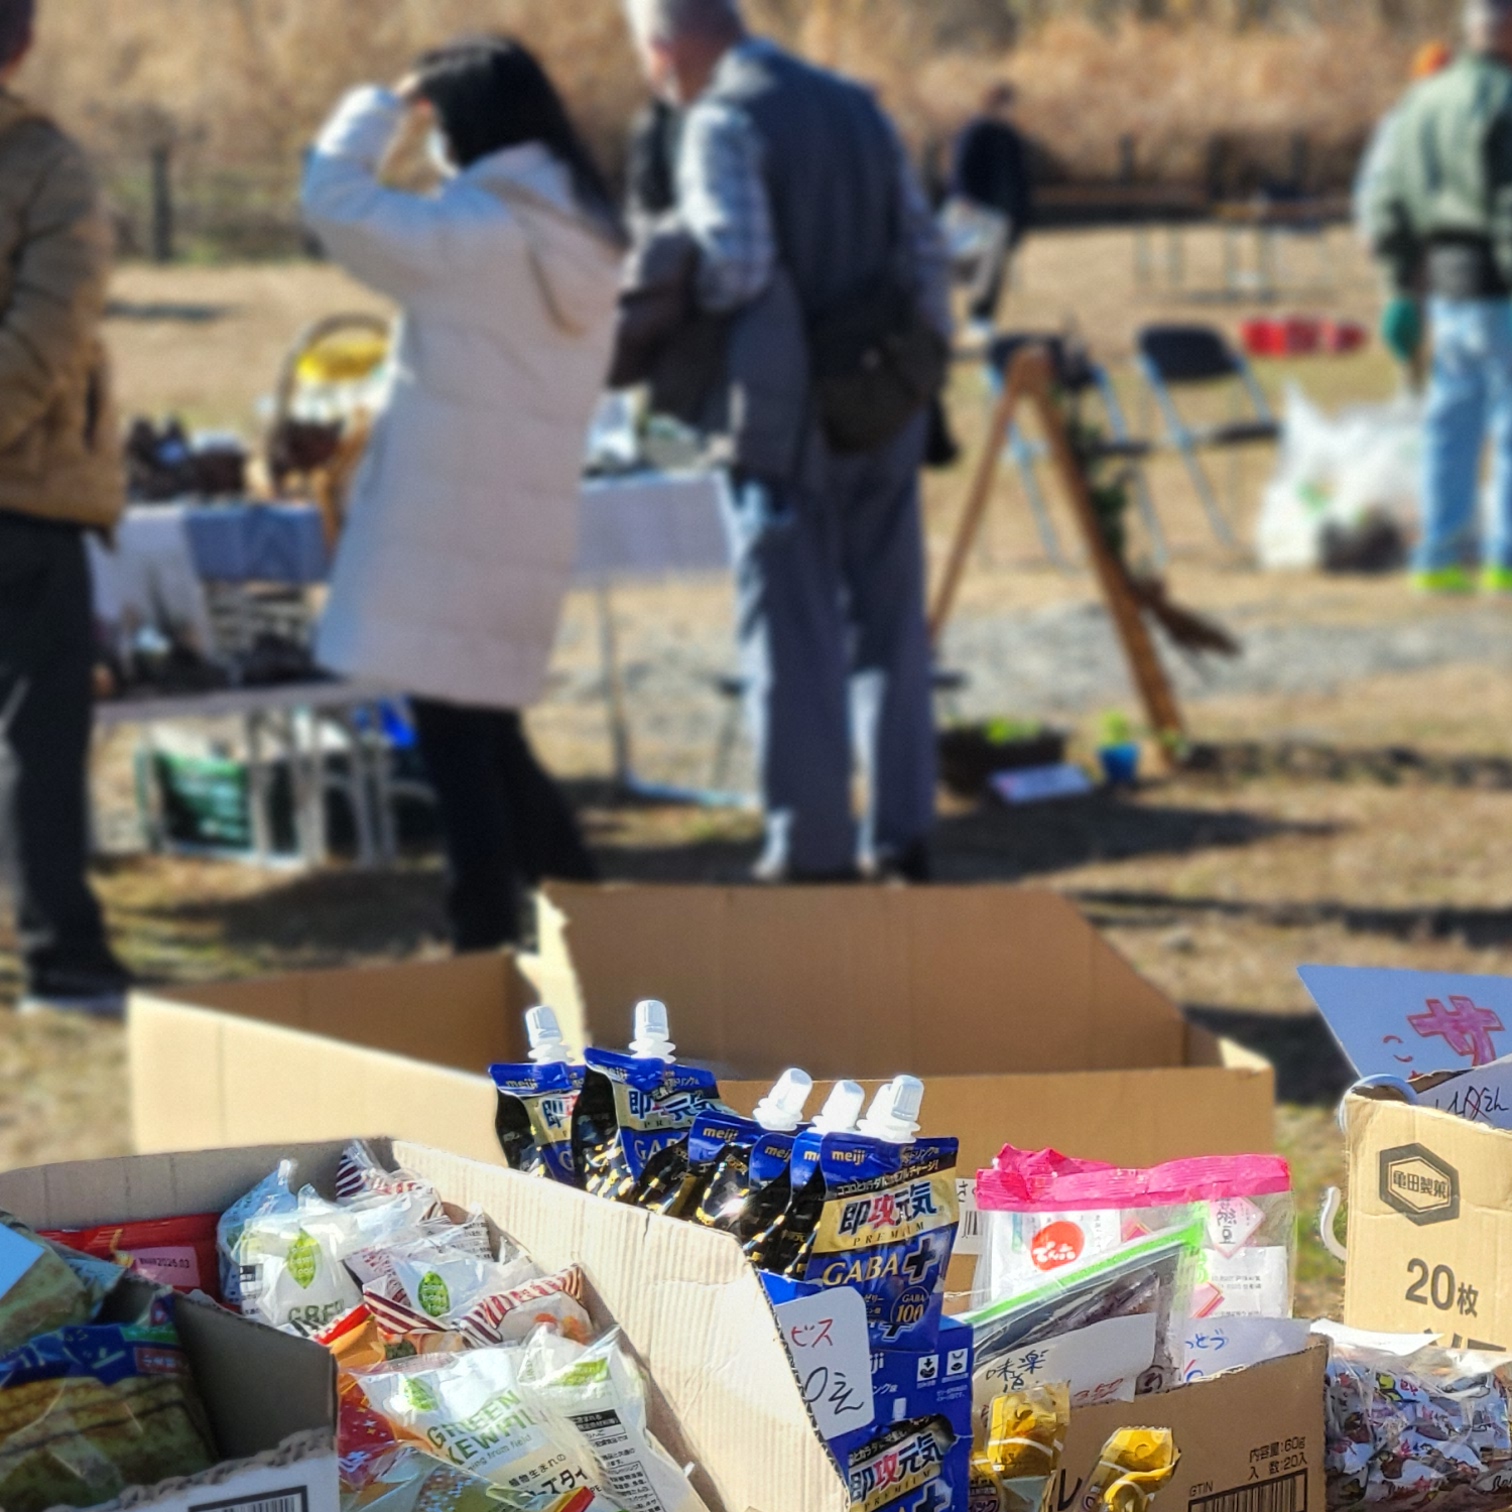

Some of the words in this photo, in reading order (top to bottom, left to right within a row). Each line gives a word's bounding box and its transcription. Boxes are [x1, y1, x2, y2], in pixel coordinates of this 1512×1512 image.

[702, 1126, 739, 1142] meiji
[763, 1144, 792, 1162] meij
[831, 1148, 866, 1165] meiji
[1392, 1169, 1450, 1201] 亀田製菓
[837, 1180, 939, 1237] 即攻元気
[821, 1254, 900, 1287] GABA
[1405, 1257, 1479, 1318] 20枚
[896, 1302, 924, 1322] 100
[426, 1389, 522, 1450] GREEN
